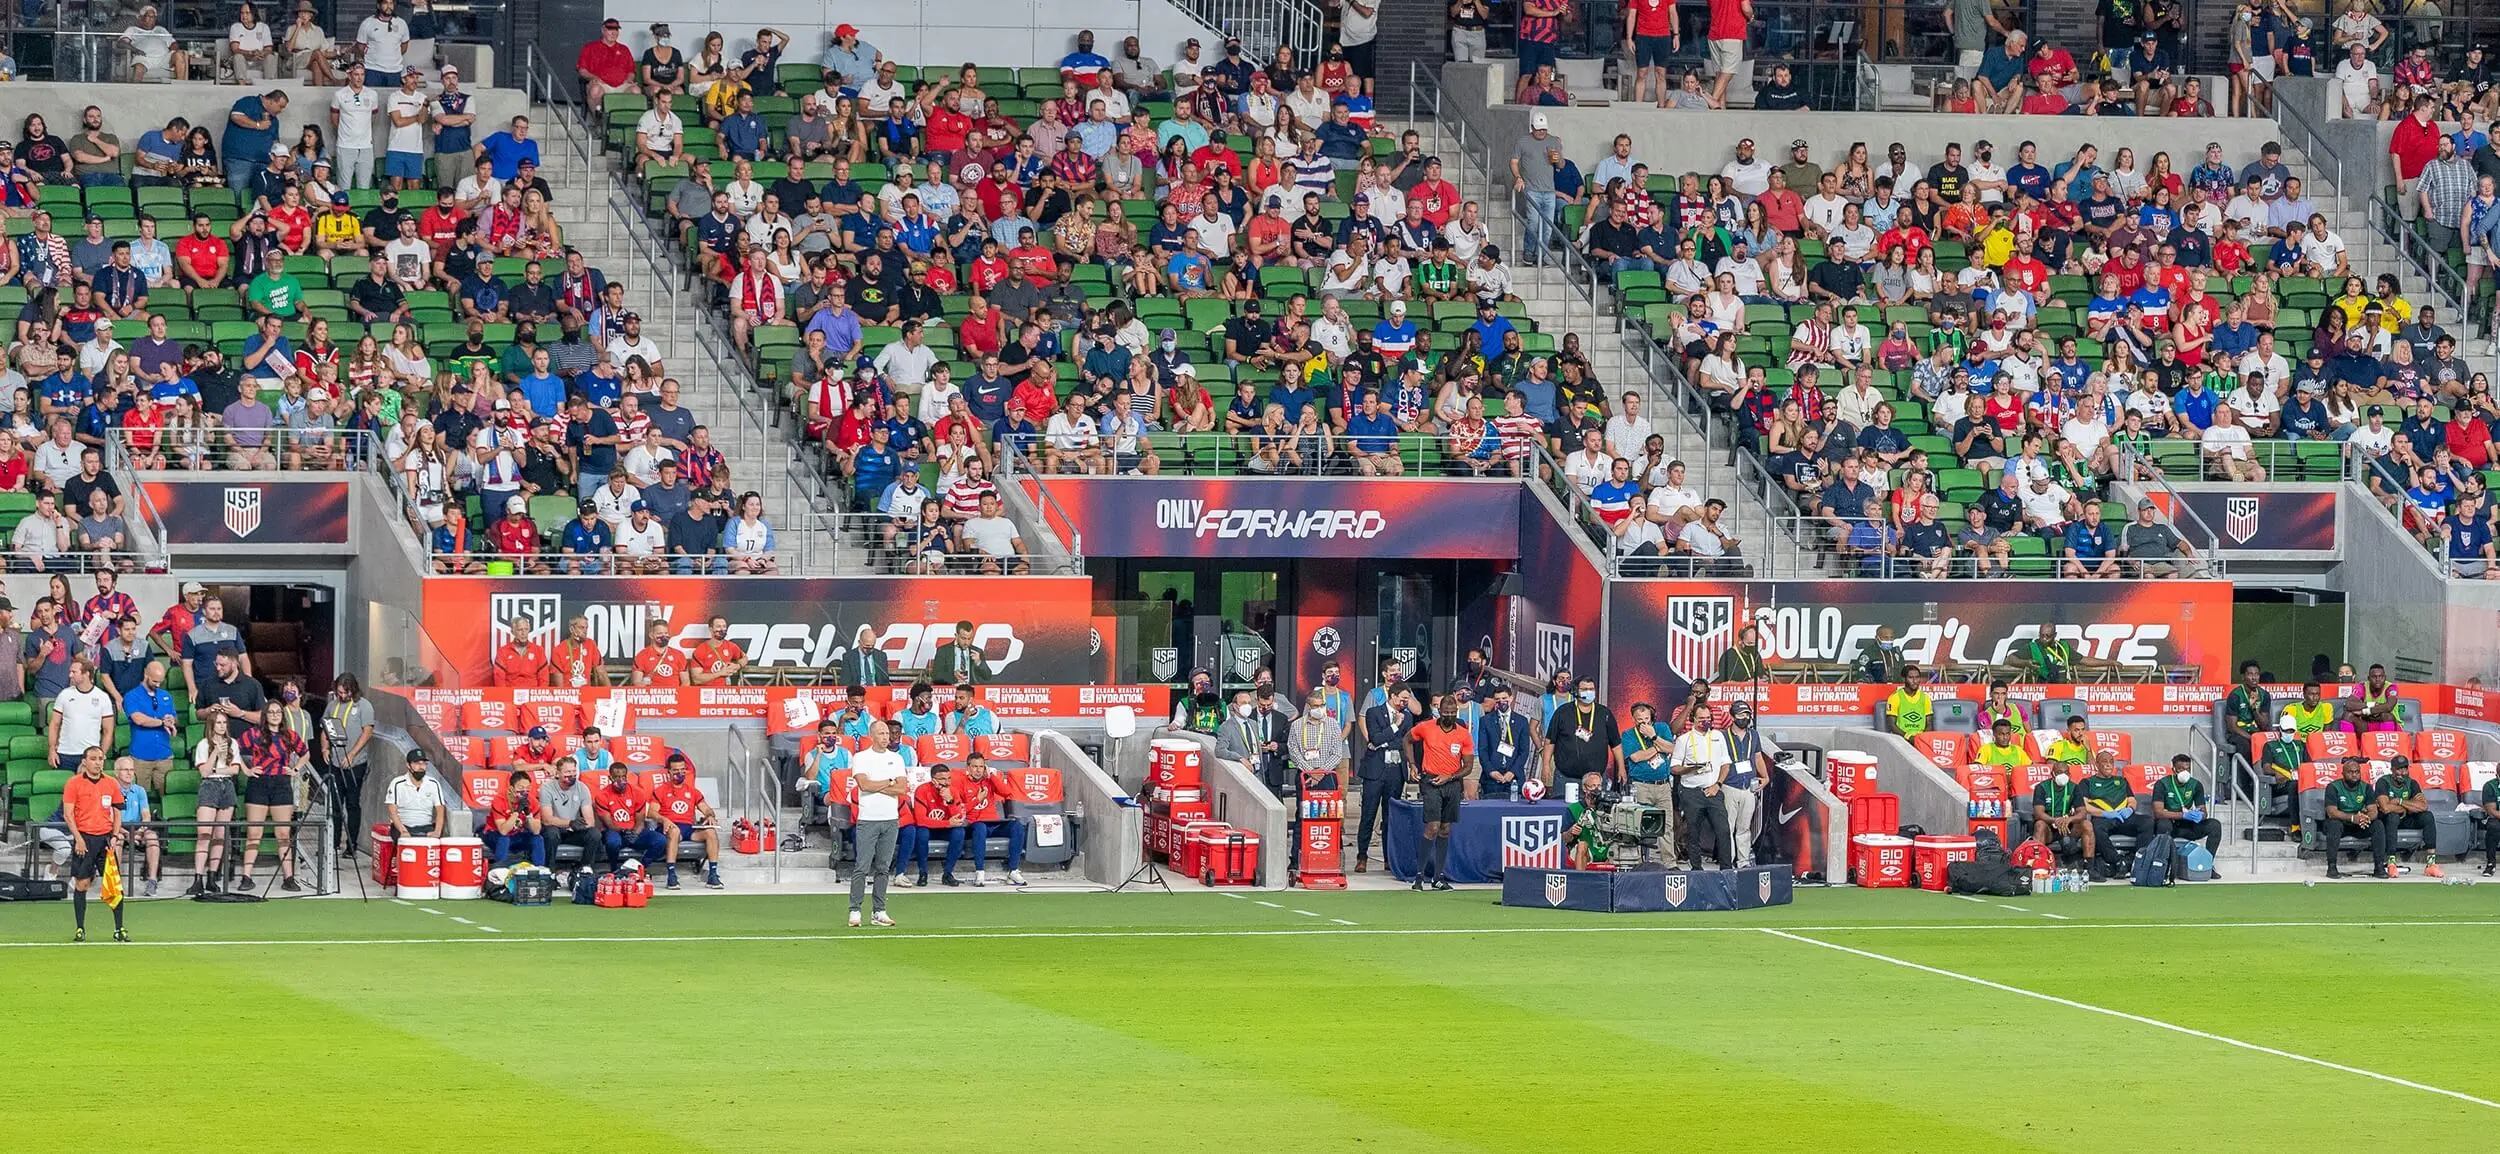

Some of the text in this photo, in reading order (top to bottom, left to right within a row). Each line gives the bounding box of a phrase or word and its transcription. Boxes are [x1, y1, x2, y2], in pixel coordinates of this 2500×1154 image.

[1428, 280, 1450, 290] YETI
[1331, 335, 1338, 345] 8
[227, 490, 259, 510] USA
[2229, 500, 2256, 518] USA
[1156, 498, 1386, 539] ONLY FORWARD
[745, 539, 755, 551] 17
[496, 598, 556, 632] USA
[1672, 600, 1729, 636] USA
[1754, 607, 1842, 660] SOLO
[1154, 650, 1177, 664] USA
[1237, 650, 1259, 664] USA
[1538, 627, 1573, 677] USA
[480, 702, 505, 710] BIO
[537, 706, 563, 716] BIO
[626, 737, 651, 745] BIO
[933, 735, 958, 743] BIO
[2096, 733, 2119, 742] BIO
[2322, 732, 2346, 741] BIO
[2375, 732, 2399, 741] BIO
[2431, 732, 2455, 742] BIO
[1932, 739, 1955, 750] BIO
[2313, 762, 2338, 770] BIO
[2421, 762, 2445, 770] BIO
[473, 779, 498, 788] BIO
[1024, 774, 1049, 784] BIO
[1310, 825, 1332, 835] BIO
[1506, 819, 1559, 851] USA
[1880, 849, 1904, 859] BIO
[1547, 876, 1565, 888] USA
[1667, 877, 1686, 889] USA
